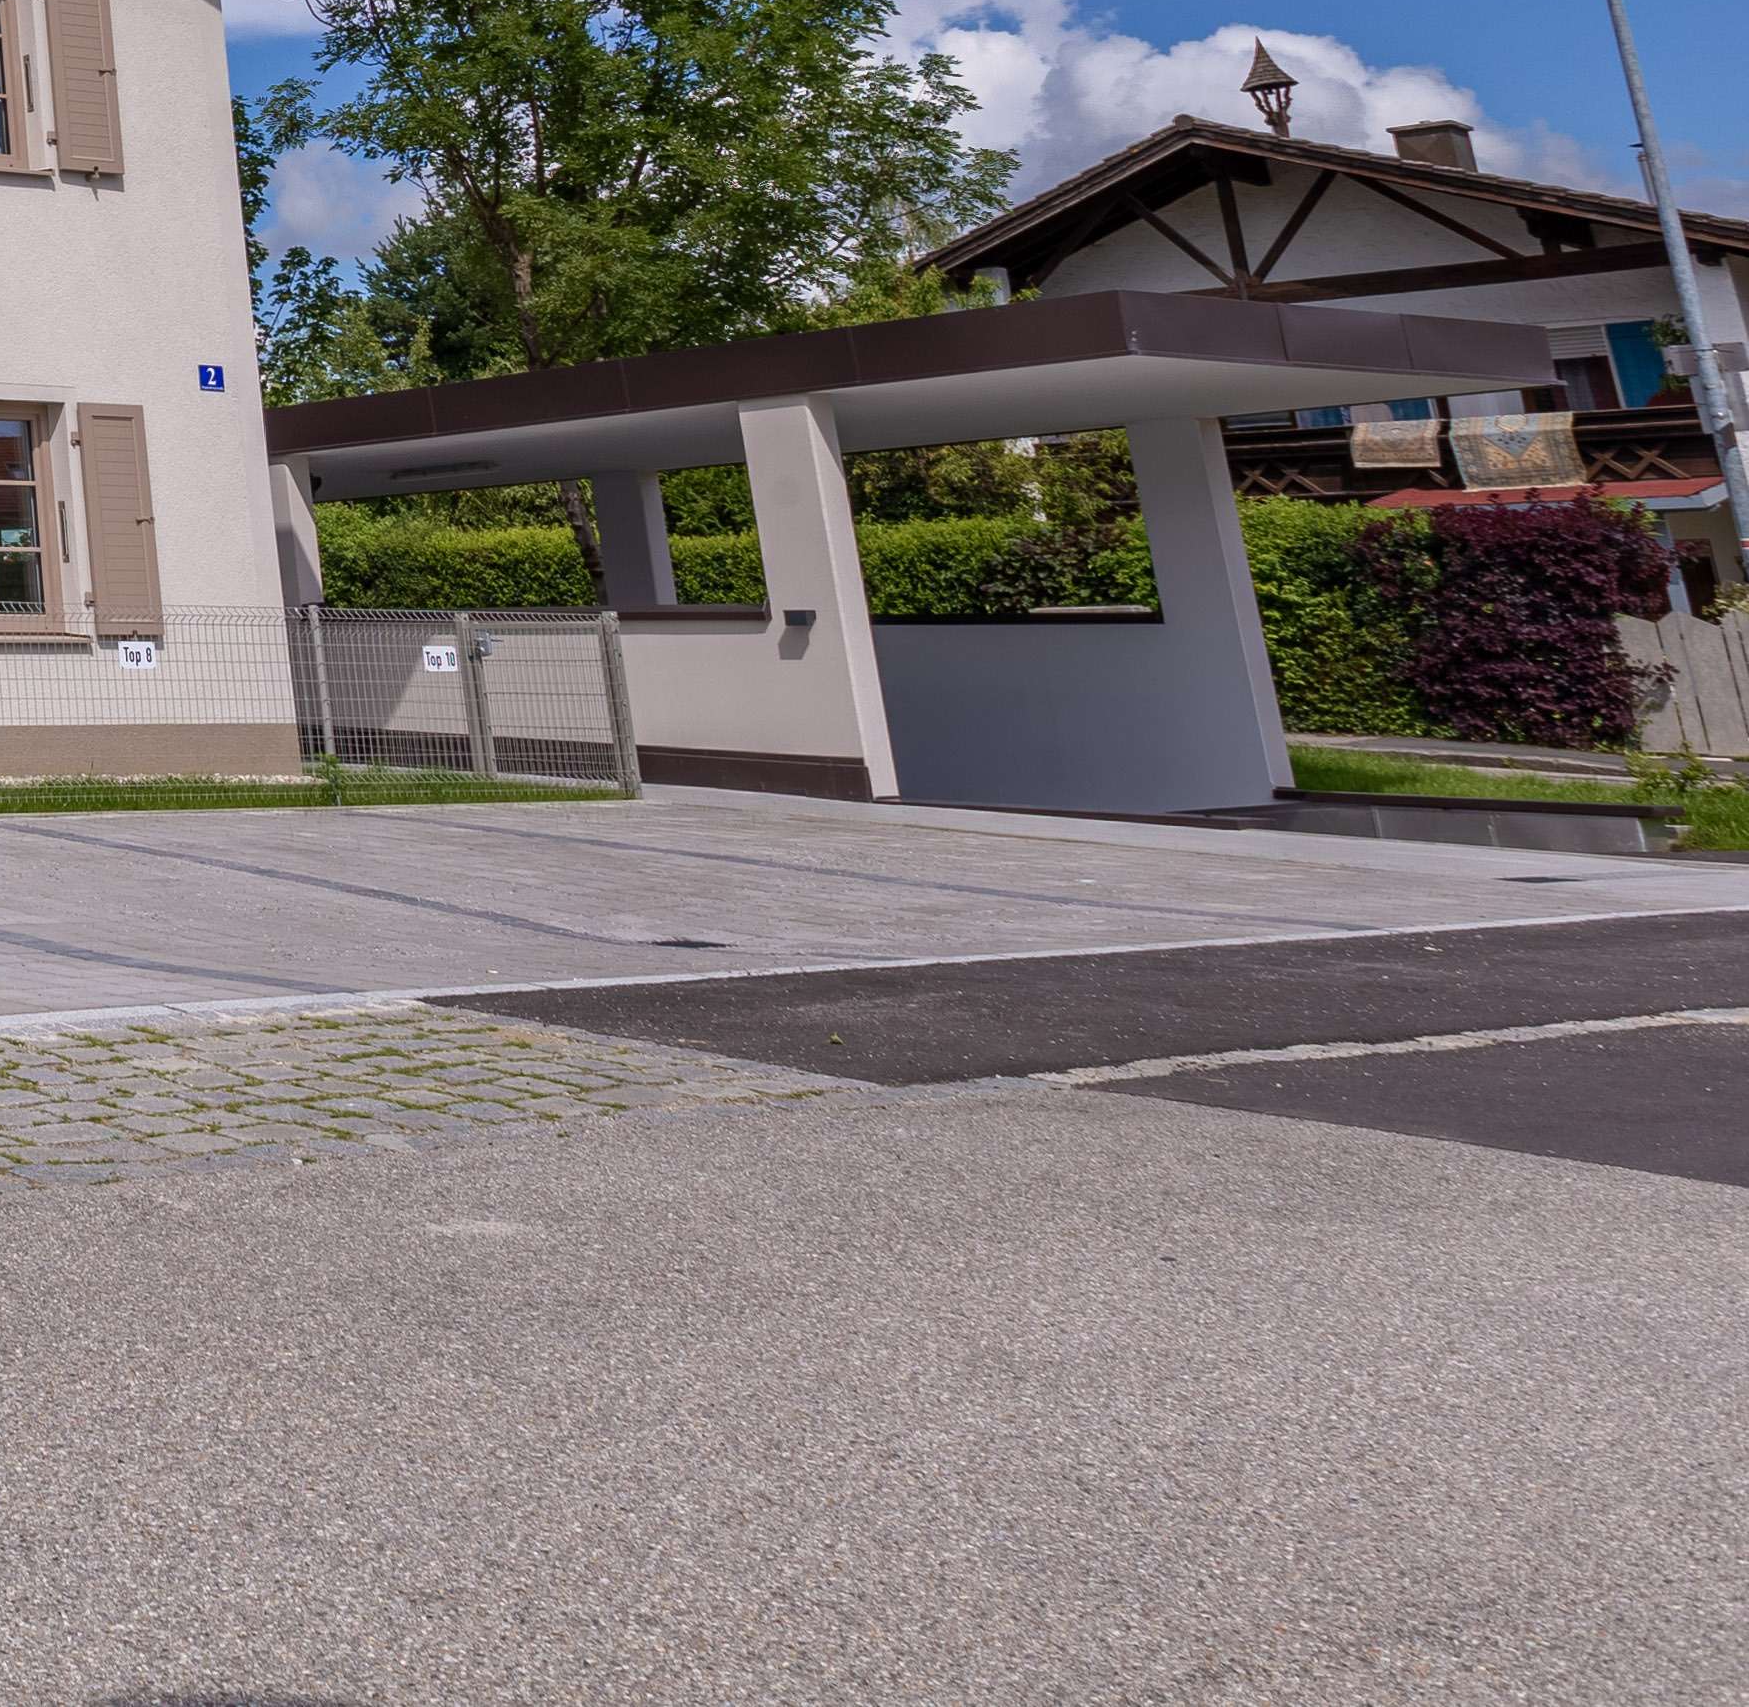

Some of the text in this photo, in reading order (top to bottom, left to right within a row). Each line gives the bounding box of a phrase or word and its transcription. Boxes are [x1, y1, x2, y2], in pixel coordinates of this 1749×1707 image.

[206, 367, 217, 385] 2
[123, 646, 153, 667] Top 8
[425, 651, 456, 669] Top 10
